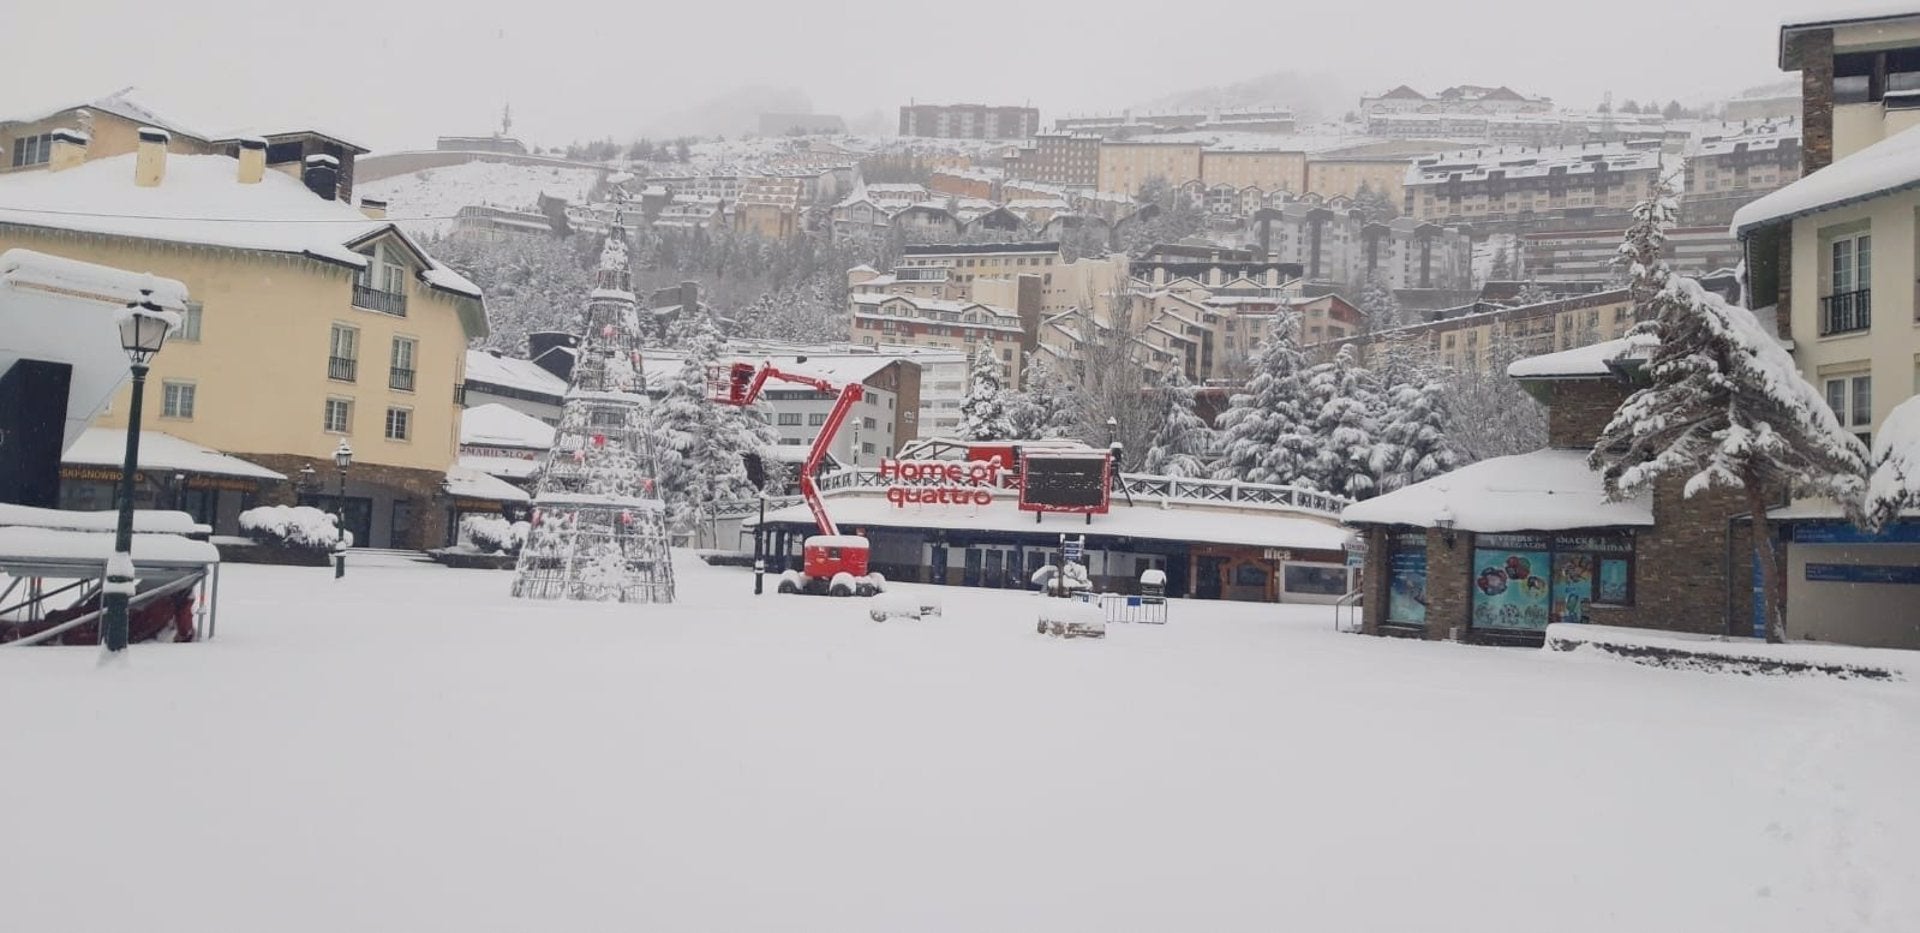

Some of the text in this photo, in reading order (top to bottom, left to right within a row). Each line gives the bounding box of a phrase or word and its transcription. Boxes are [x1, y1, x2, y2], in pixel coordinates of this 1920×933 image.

[881, 455, 1000, 485] Home of
[887, 484, 992, 508] quattro
